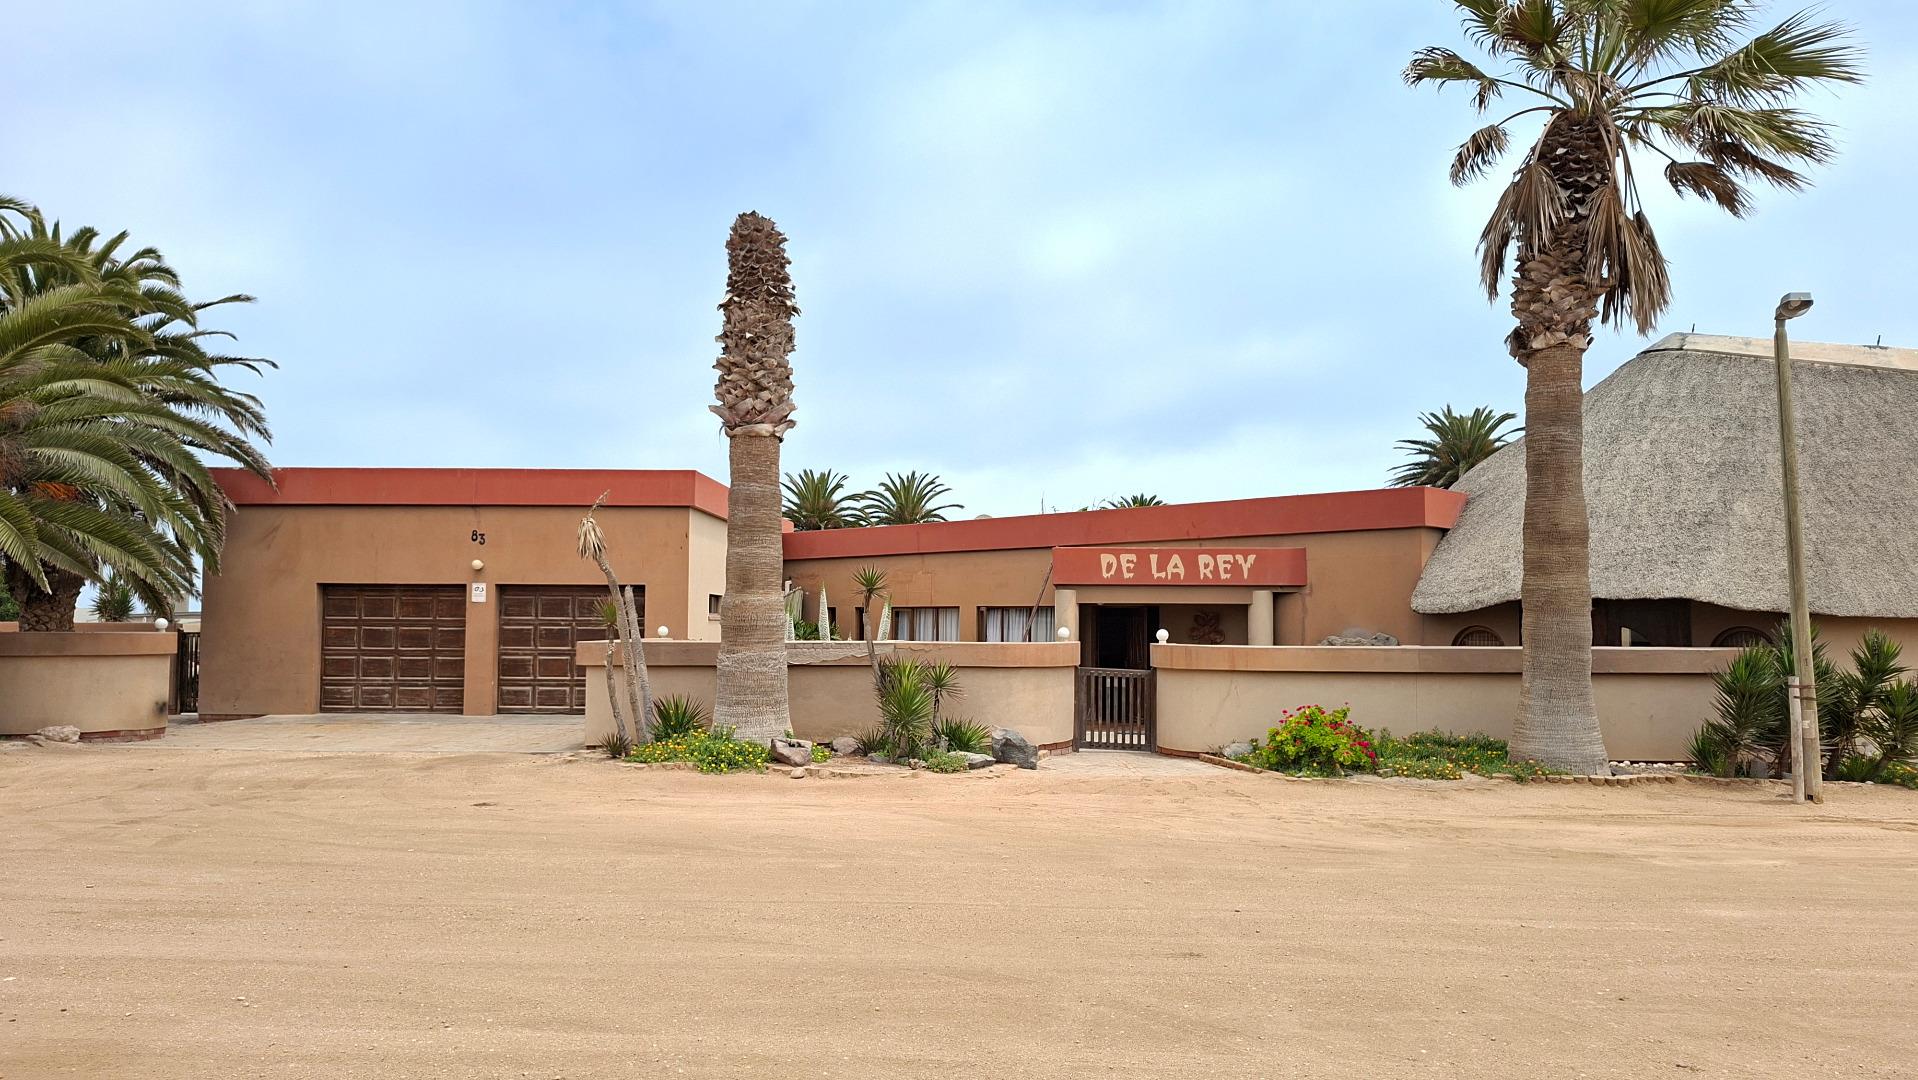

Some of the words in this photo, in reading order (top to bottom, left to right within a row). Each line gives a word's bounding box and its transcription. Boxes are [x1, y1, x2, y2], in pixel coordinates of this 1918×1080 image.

[471, 529, 486, 546] 83
[1100, 553, 1137, 579] DE
[1150, 553, 1185, 580] LA
[1198, 554, 1257, 580] REY
